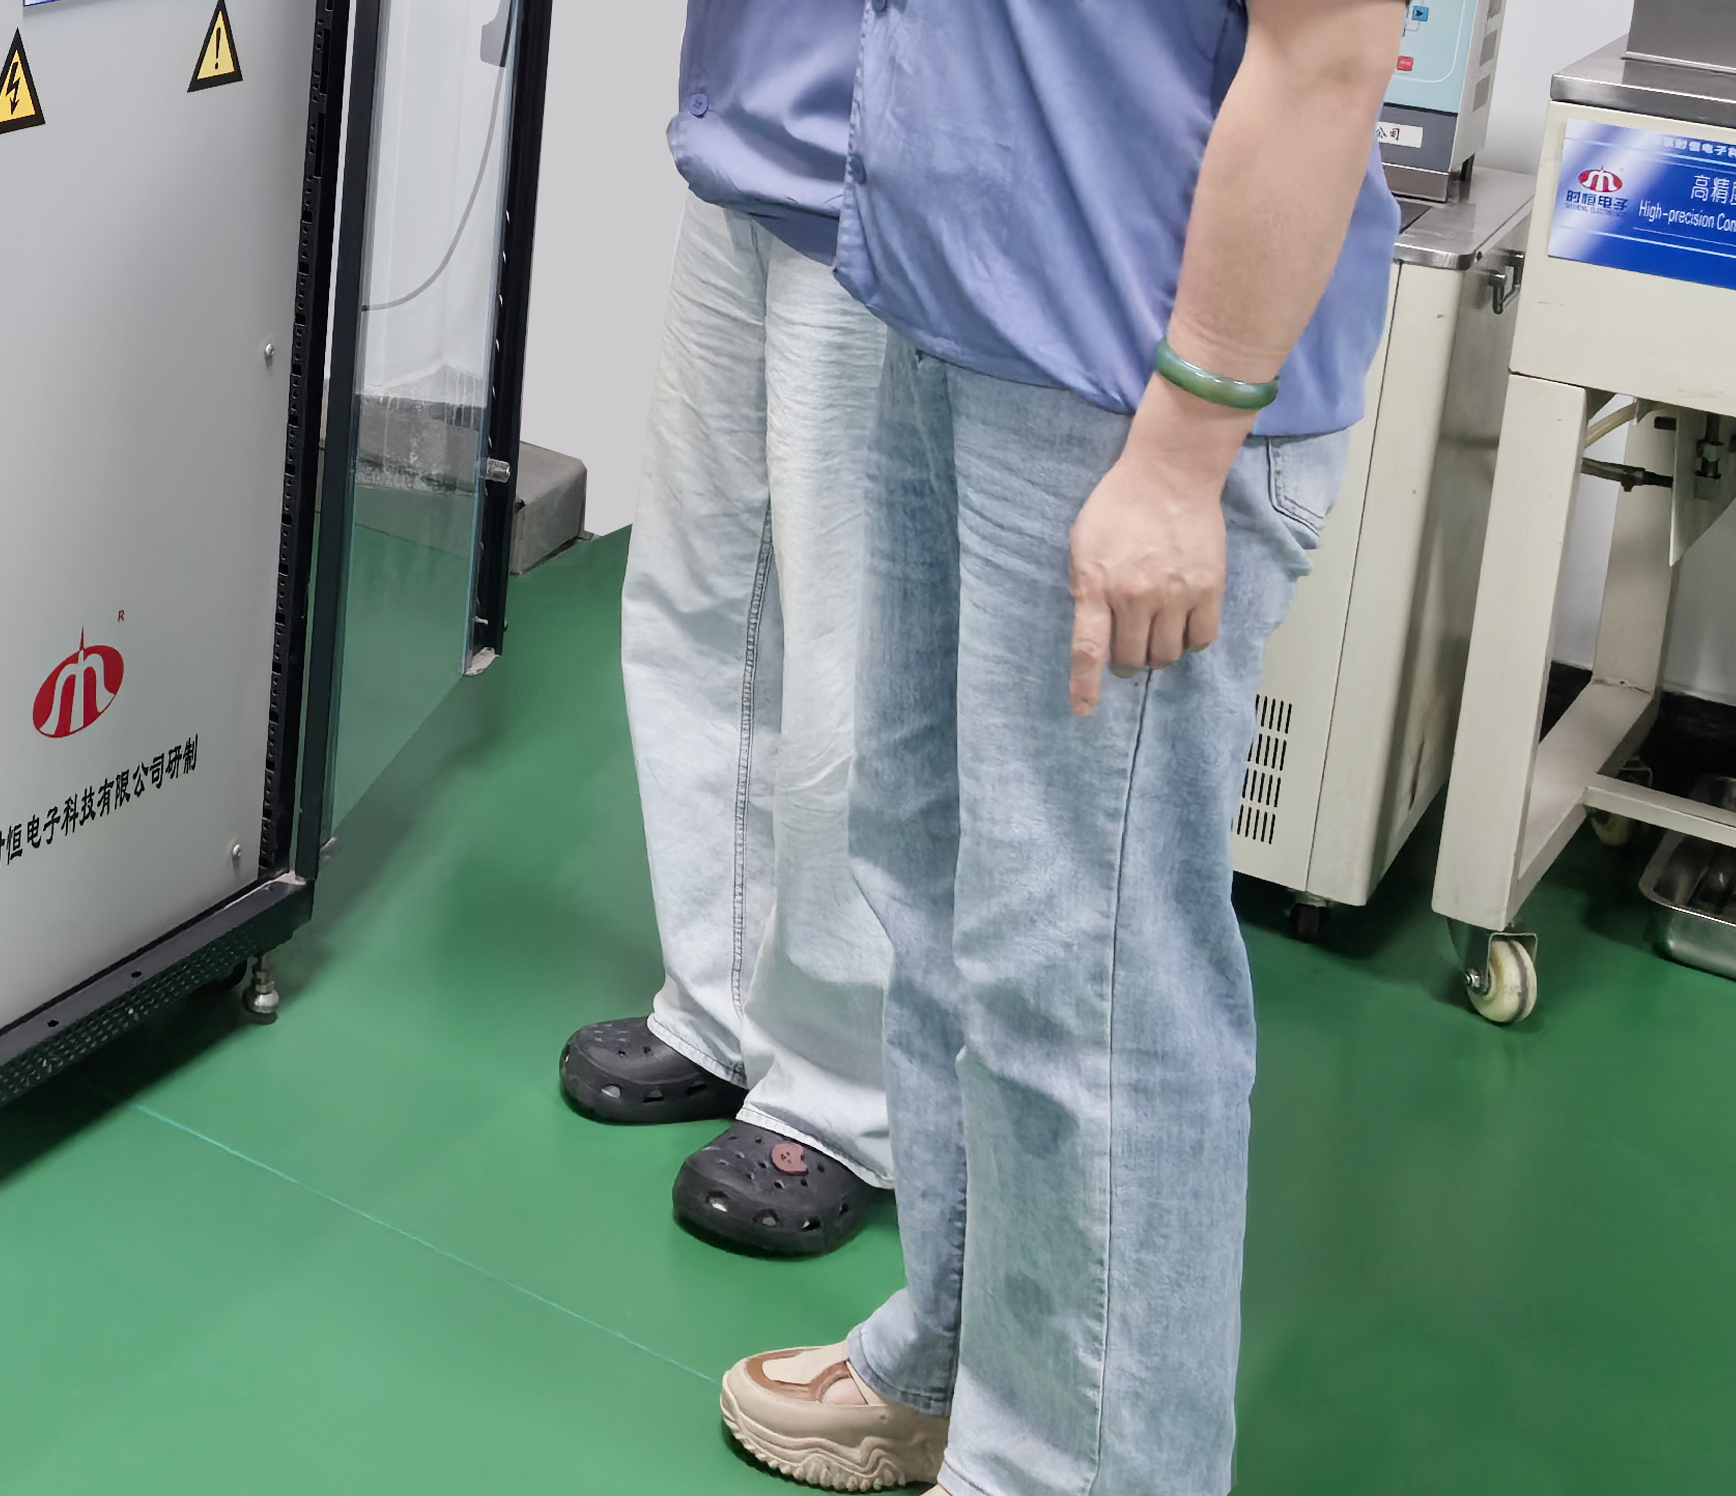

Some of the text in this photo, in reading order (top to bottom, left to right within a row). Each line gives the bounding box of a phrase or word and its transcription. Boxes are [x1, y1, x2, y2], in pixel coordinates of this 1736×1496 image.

[1566, 189, 1629, 211] 时恒电子
[1639, 199, 1714, 227] High-precision
